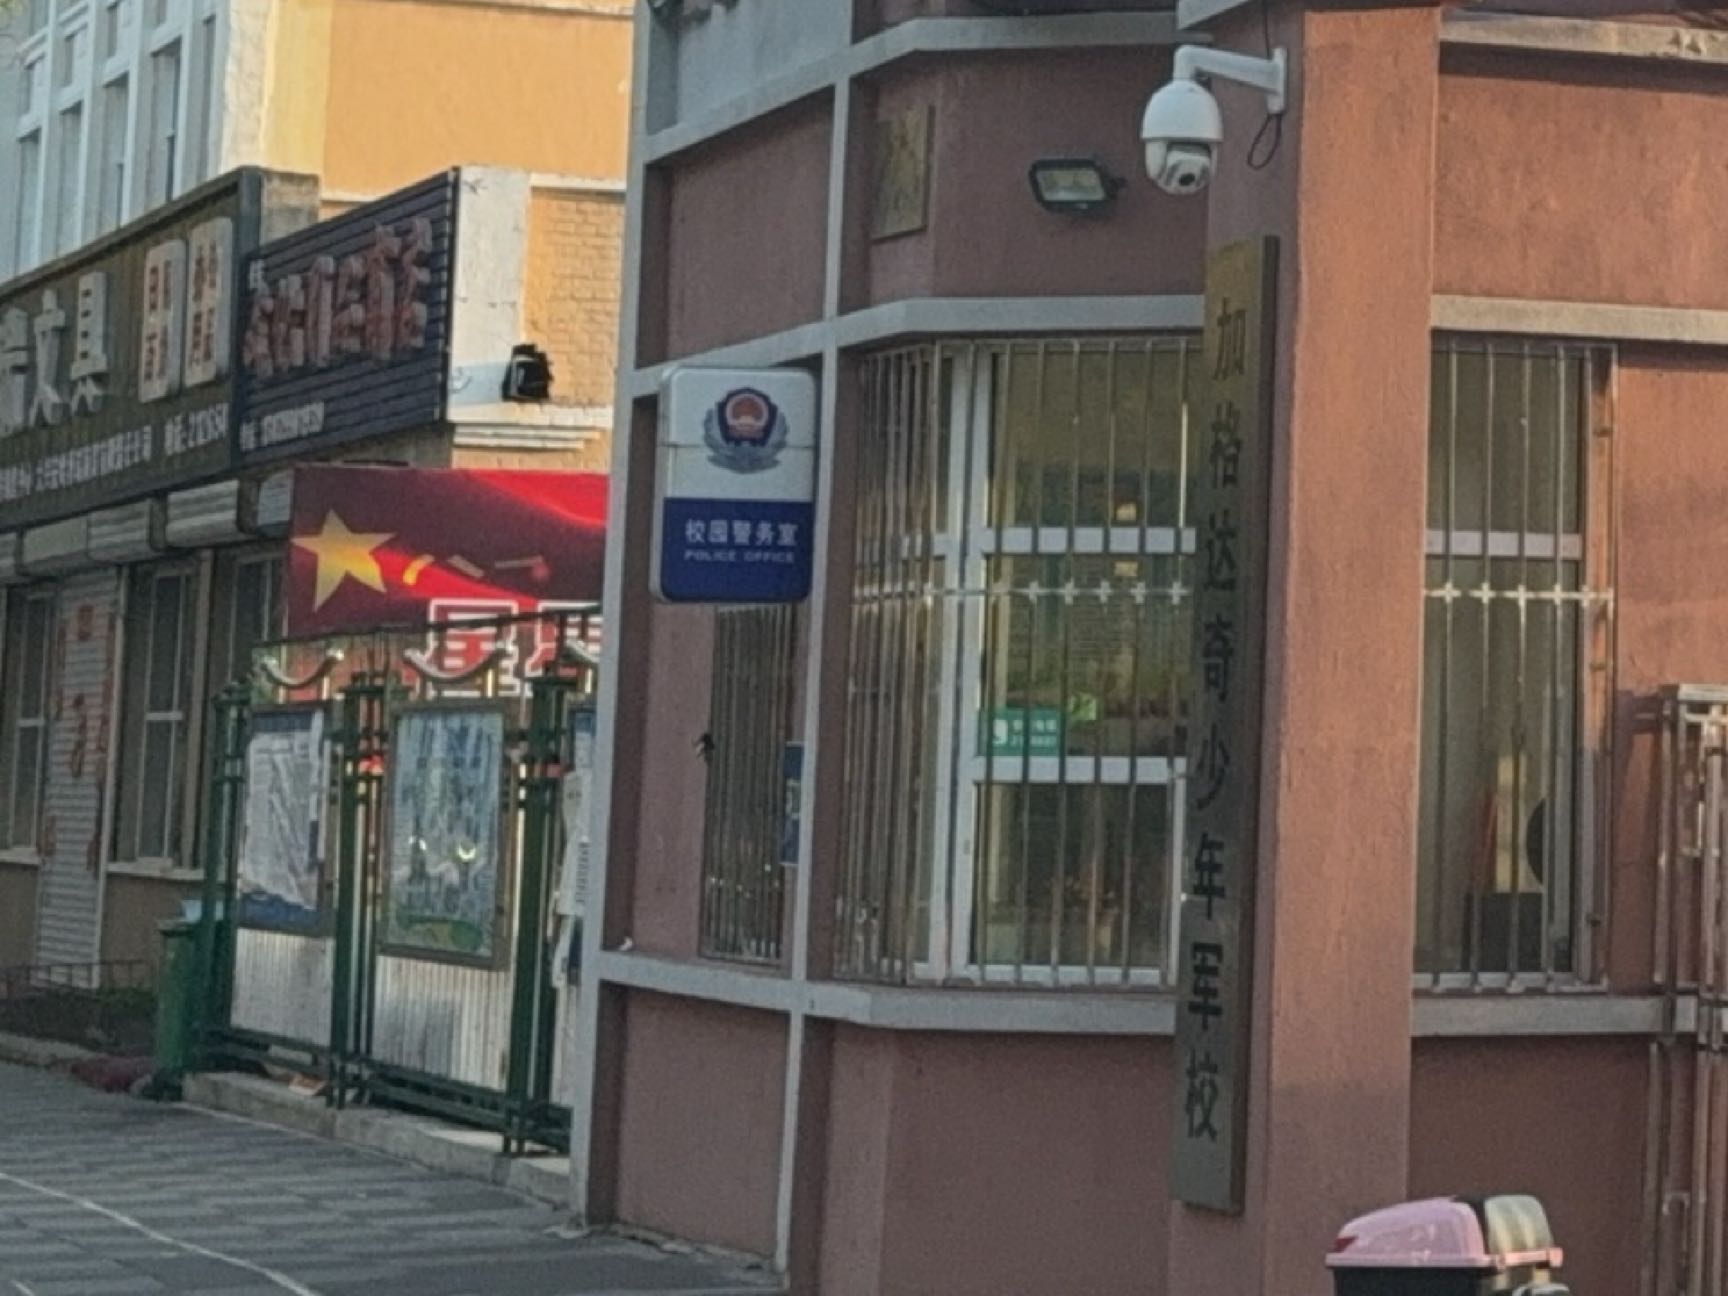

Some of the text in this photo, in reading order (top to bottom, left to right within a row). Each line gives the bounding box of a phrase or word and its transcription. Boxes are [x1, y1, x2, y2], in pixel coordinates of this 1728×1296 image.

[684, 518, 799, 547] 校园警务室
[1185, 296, 1248, 1141] 加格达奇少年军校
